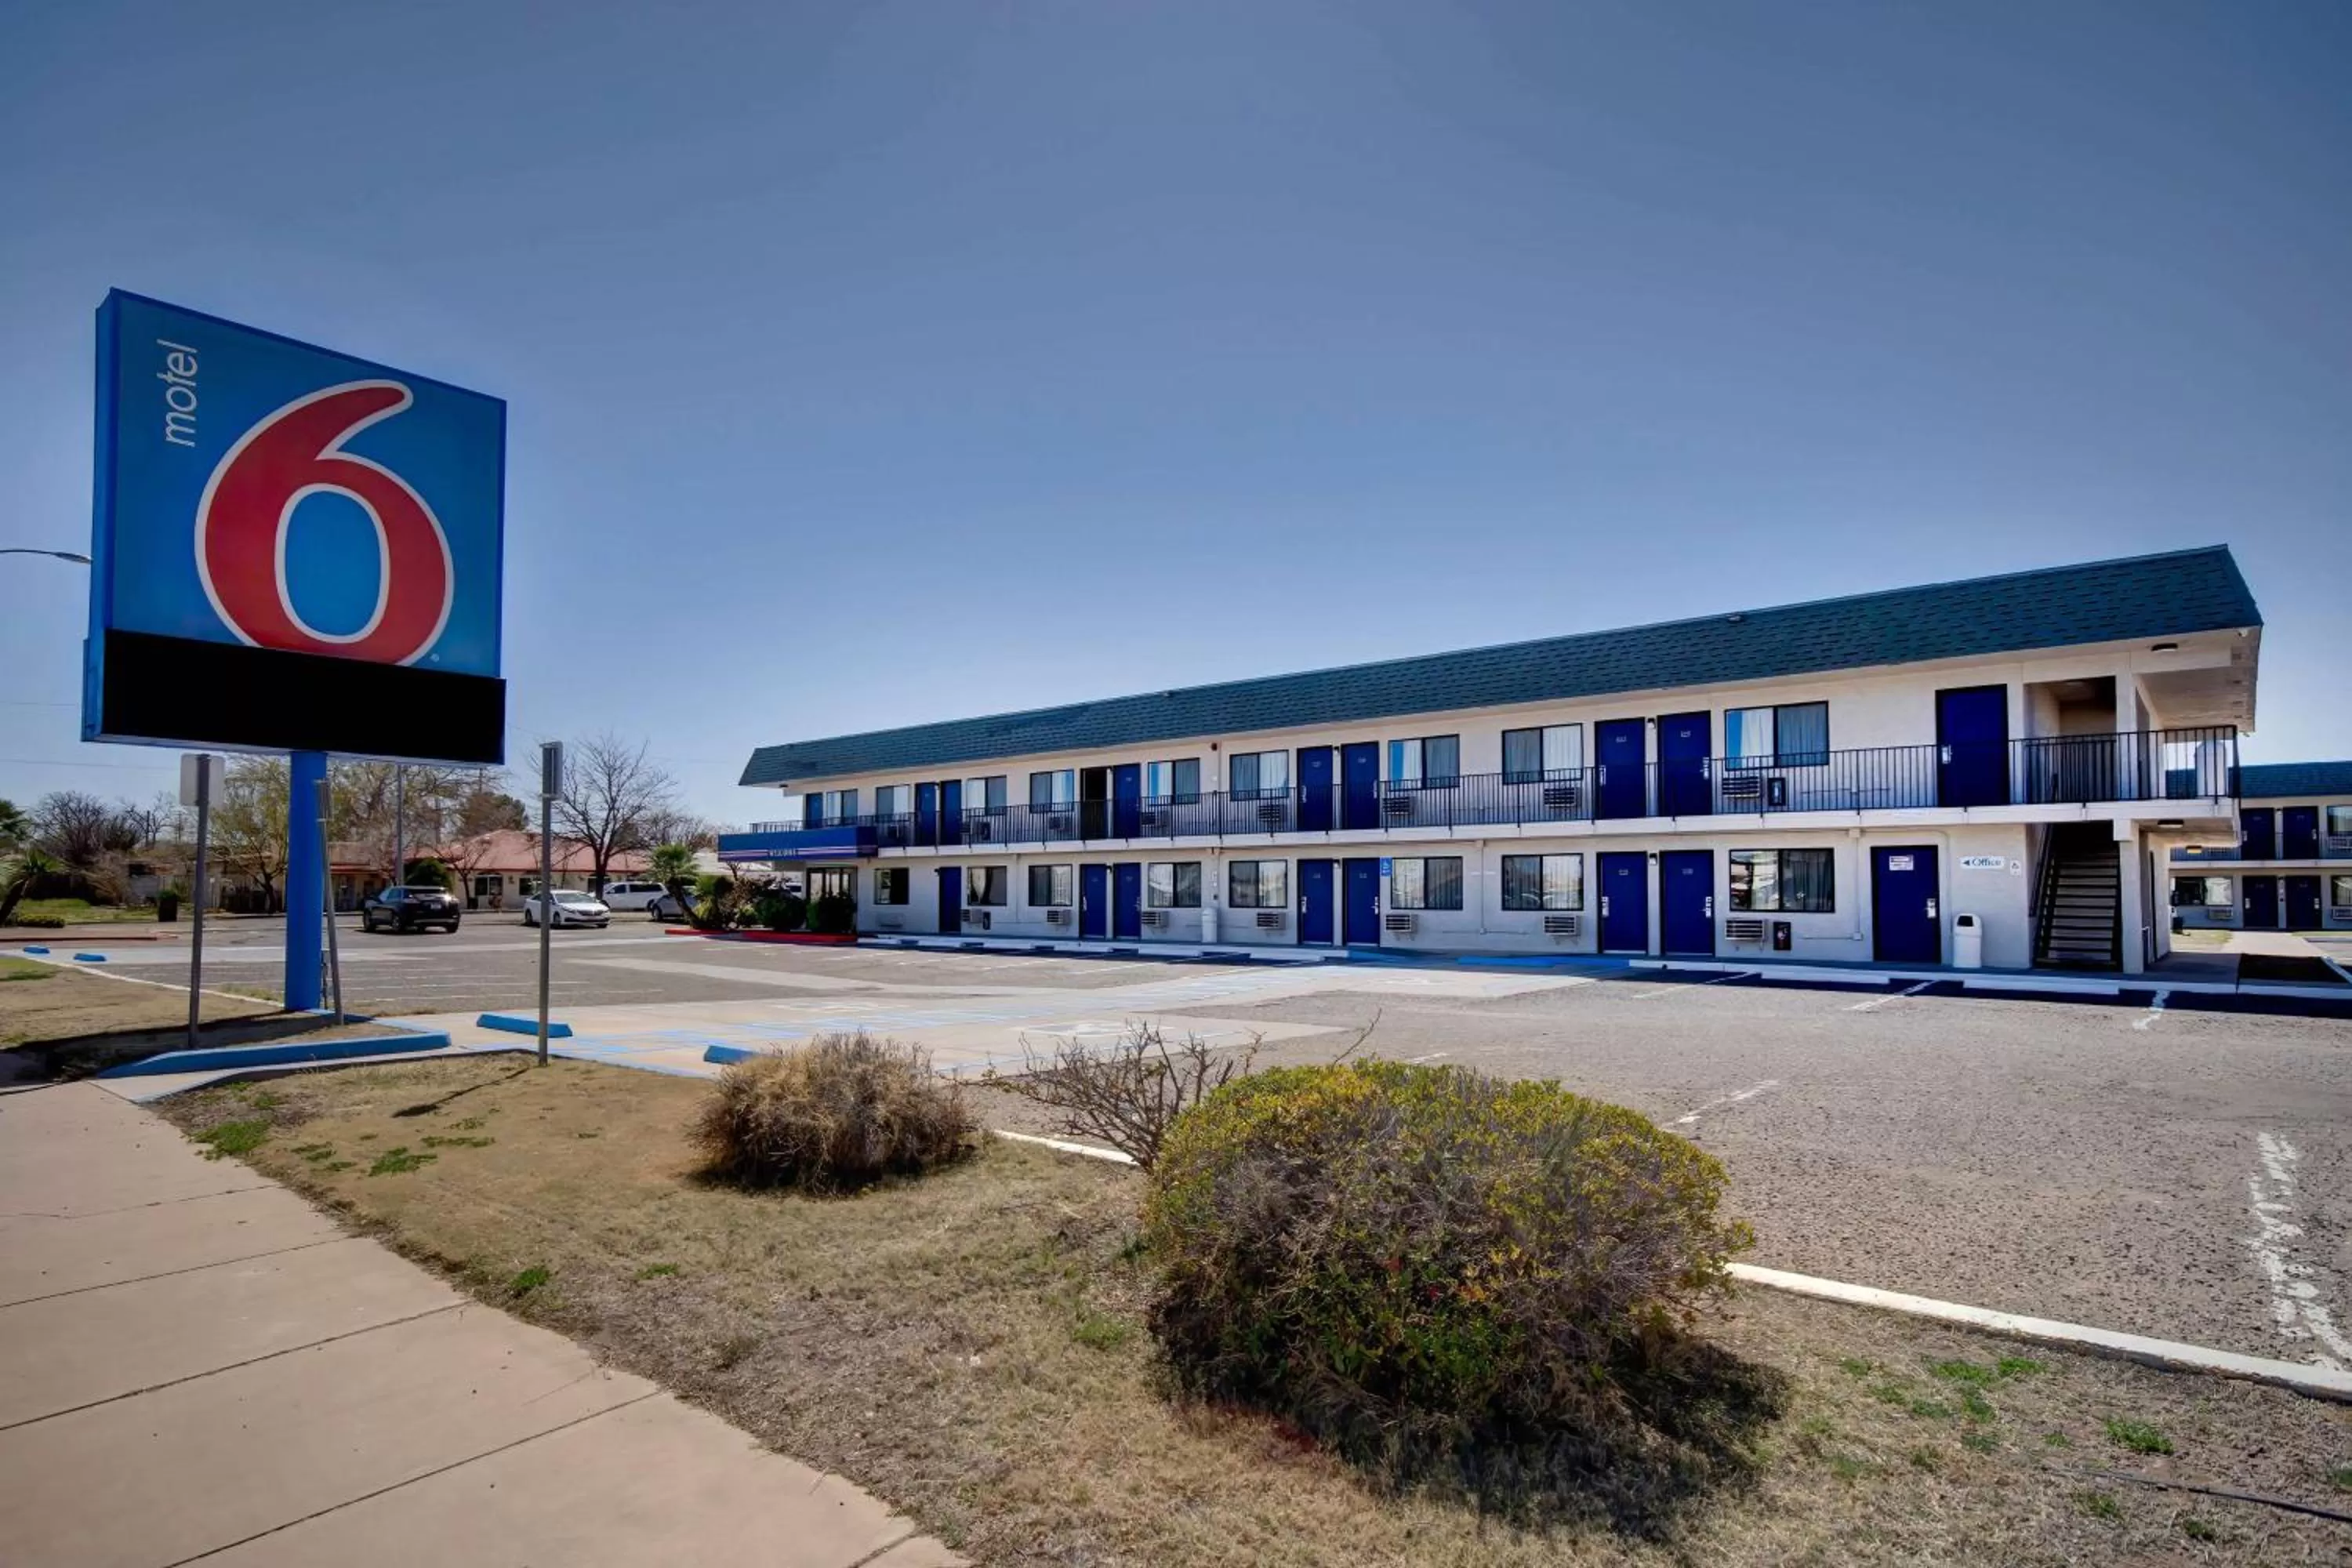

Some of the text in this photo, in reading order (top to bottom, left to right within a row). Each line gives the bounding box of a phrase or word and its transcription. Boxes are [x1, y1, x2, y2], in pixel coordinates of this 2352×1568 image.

[158, 339, 198, 447] motel
[195, 379, 455, 666] 6
[1972, 858, 2002, 866] Office
